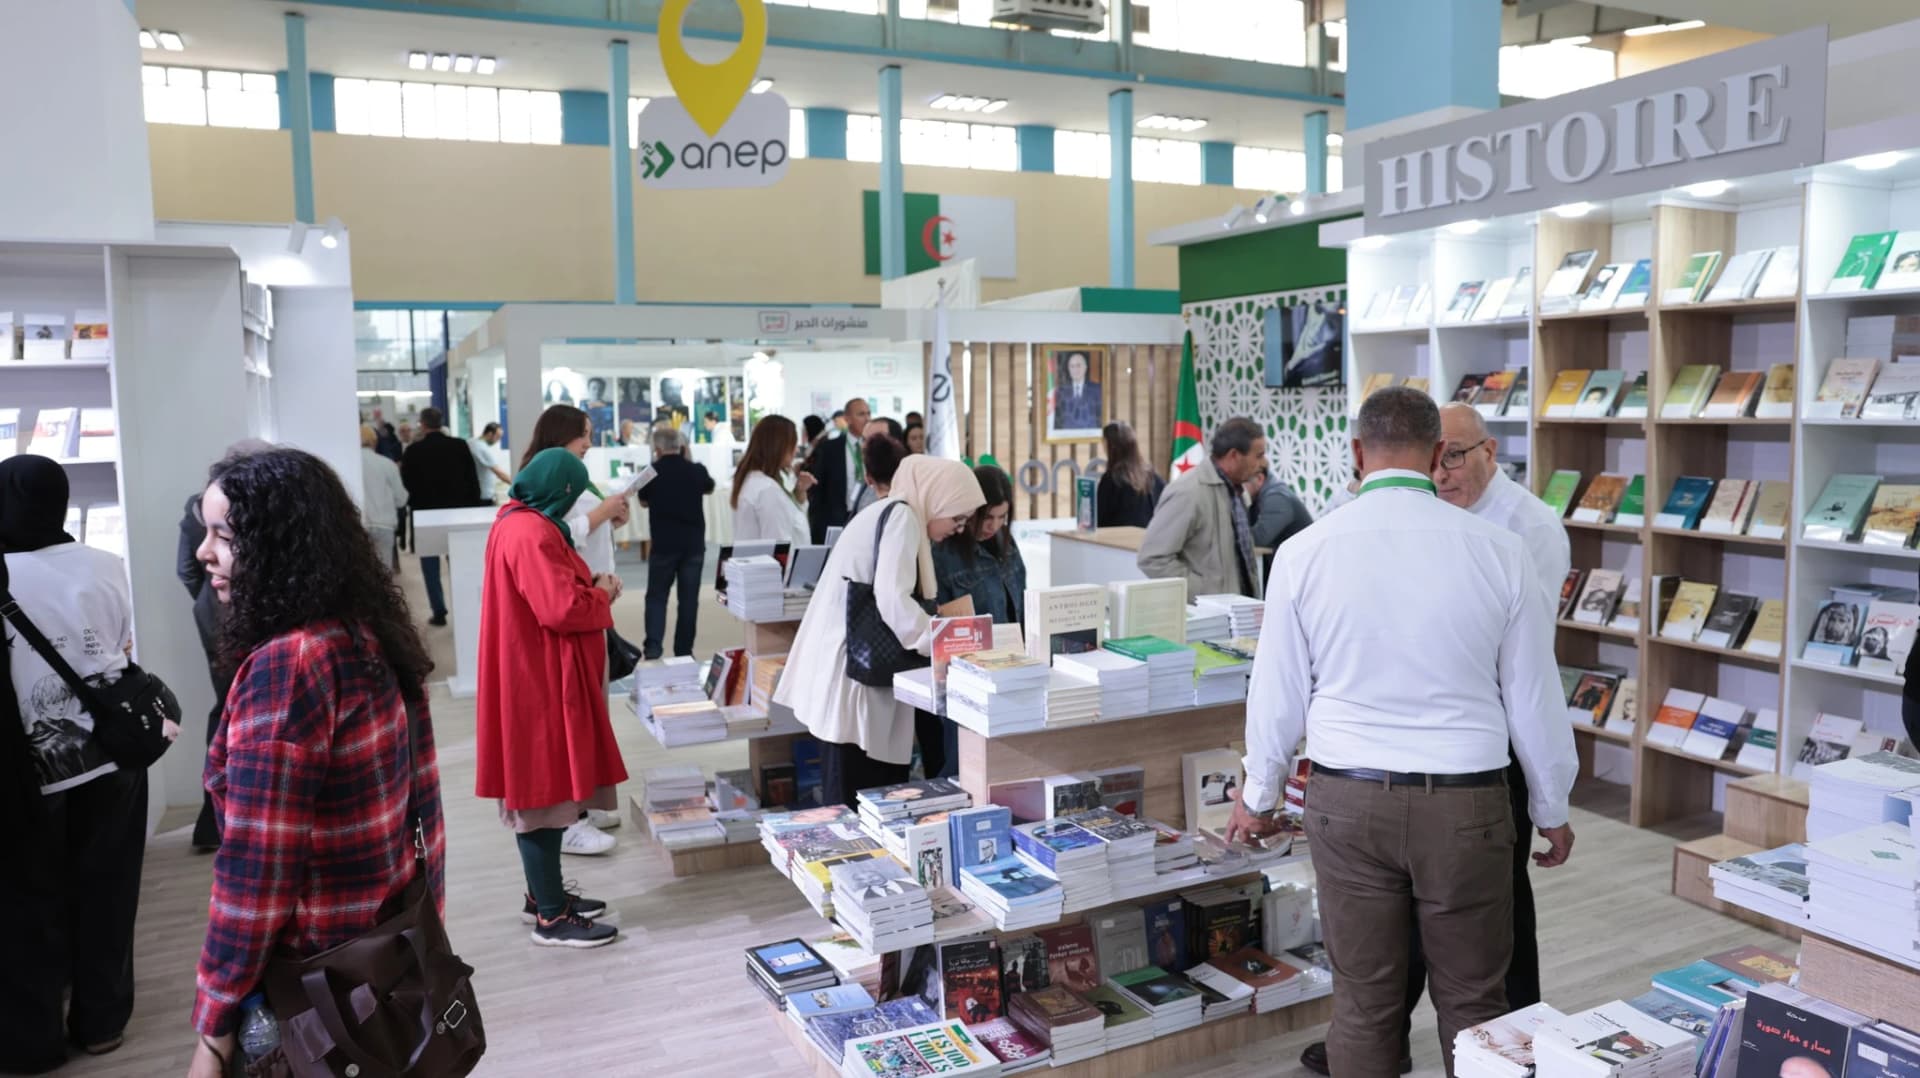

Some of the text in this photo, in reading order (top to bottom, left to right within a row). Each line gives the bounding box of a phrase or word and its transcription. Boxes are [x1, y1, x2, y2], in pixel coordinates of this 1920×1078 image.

[681, 139, 786, 174] anep
[1378, 63, 1790, 218] HISTOIRE
[821, 315, 868, 331] منشورات
